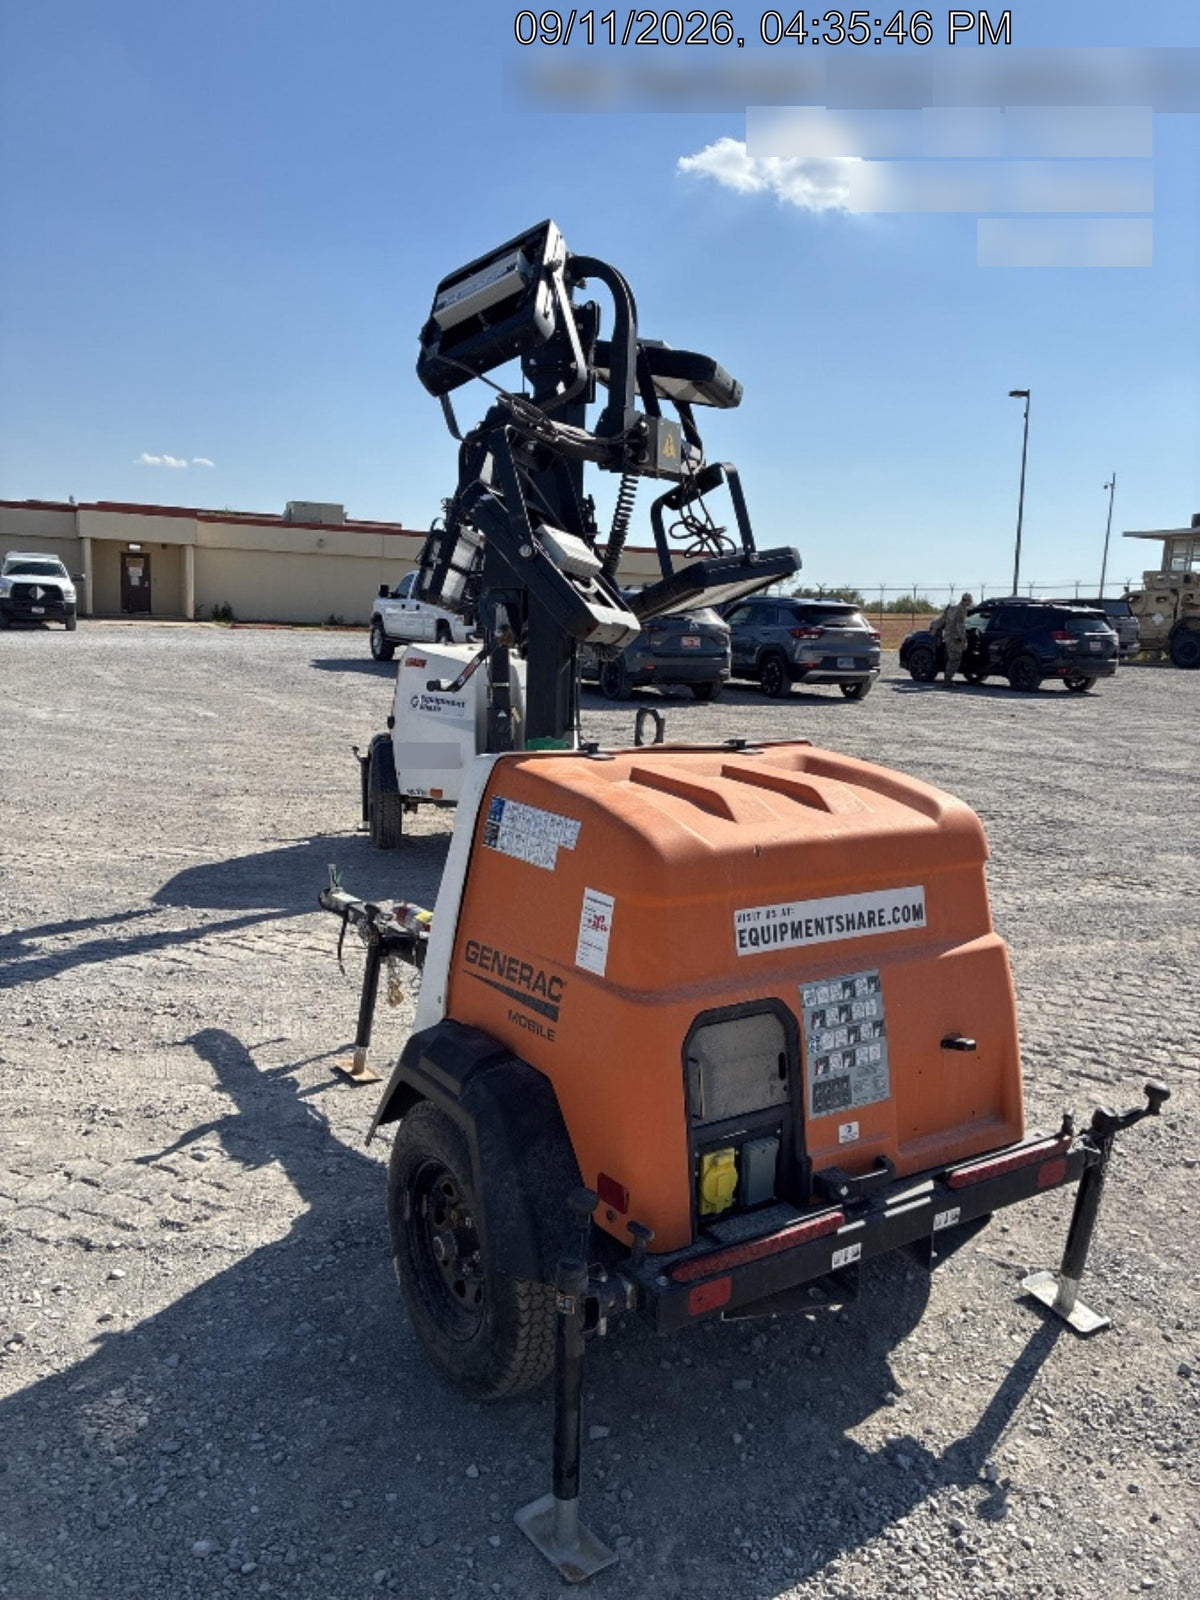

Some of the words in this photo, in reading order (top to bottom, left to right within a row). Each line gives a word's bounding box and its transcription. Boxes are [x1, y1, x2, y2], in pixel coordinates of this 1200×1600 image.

[736, 911, 761, 923] VISIT
[737, 902, 924, 948] EQUIPMENTSHARE.COM
[465, 939, 563, 1003] GENERAC
[508, 1009, 556, 1042] MOBILE
